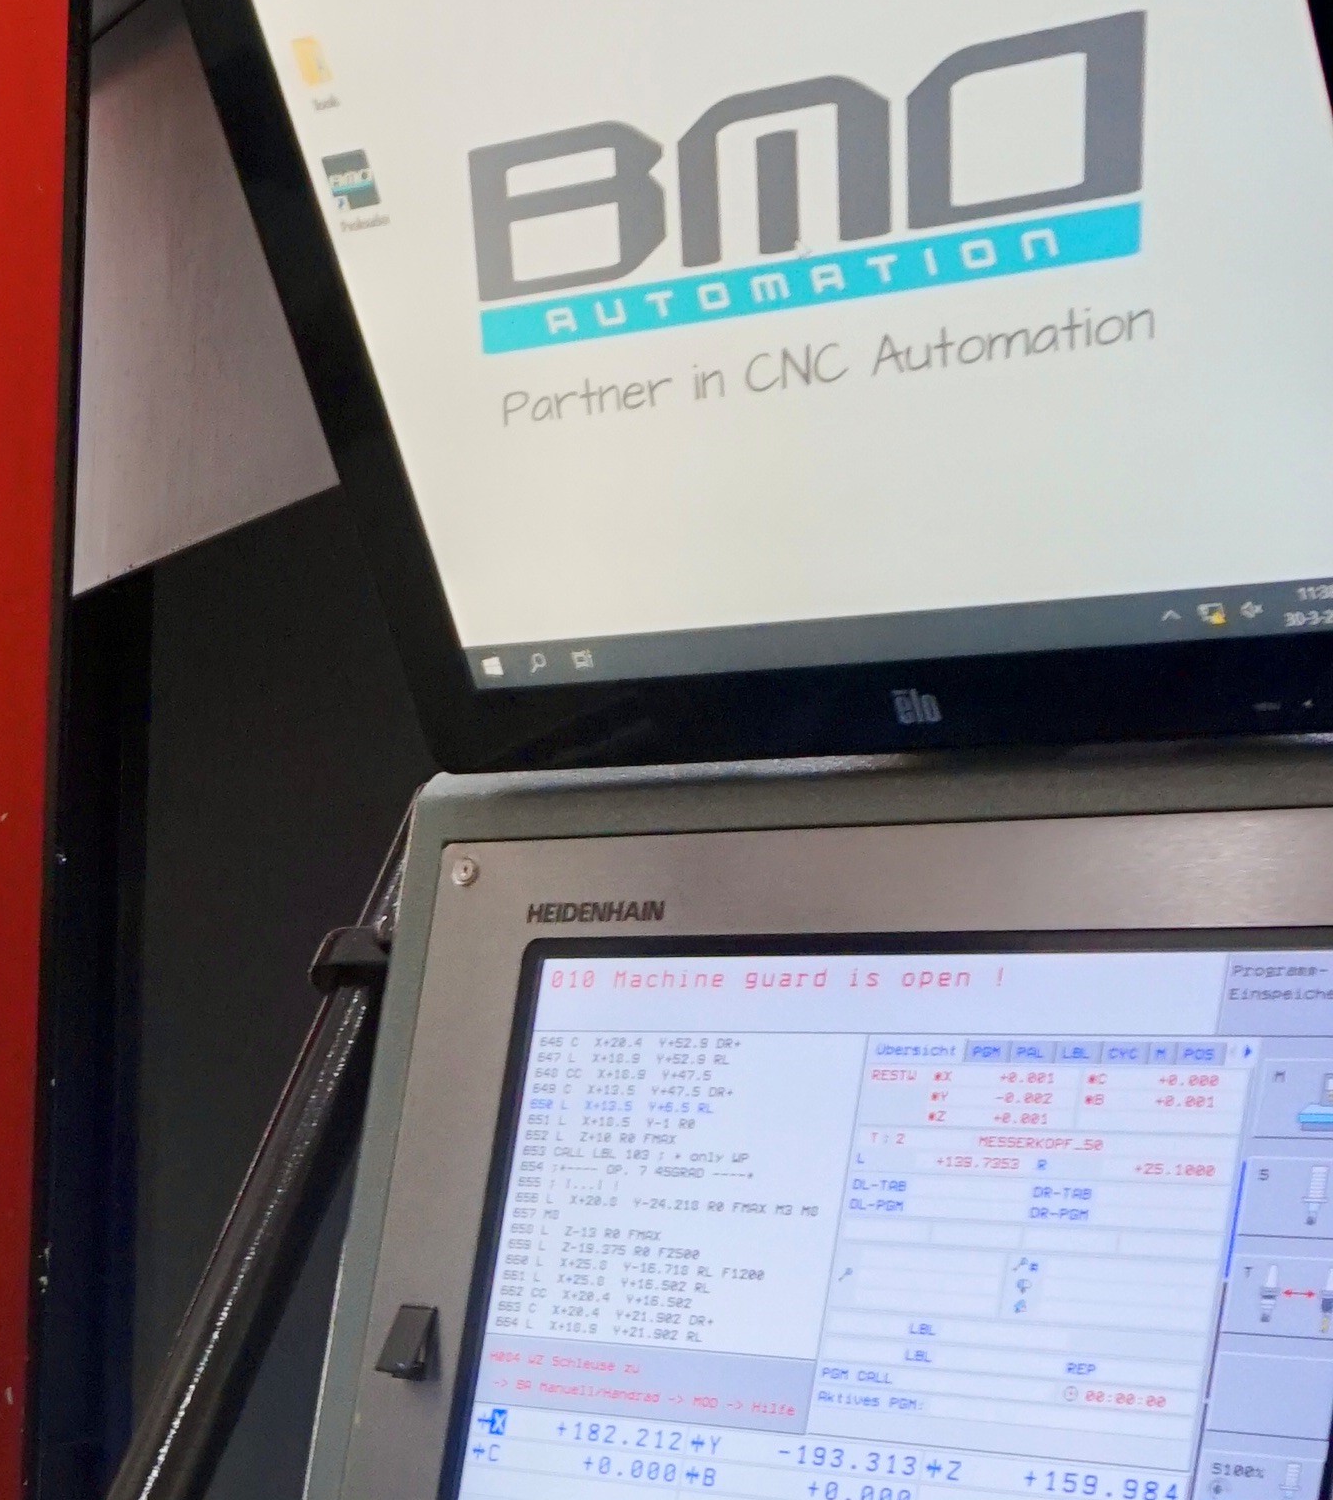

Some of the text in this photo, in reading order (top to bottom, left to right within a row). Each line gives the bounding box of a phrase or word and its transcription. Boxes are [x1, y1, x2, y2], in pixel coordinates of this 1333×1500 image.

[469, 10, 1147, 302] BMO
[546, 228, 1059, 334] AUTOMATION
[503, 304, 1156, 425] Partner in CNC Automation
[527, 901, 665, 924] HEIDENHAIN
[551, 968, 1005, 990] 010 Machine guard is open !
[999, 1071, 1054, 1084] +0.001
[1159, 1074, 1219, 1087] +0.000
[1155, 1095, 1214, 1108] +0.001
[994, 1112, 1048, 1124] +0.001
[909, 1323, 936, 1336] LBL
[552, 1356, 615, 1372] Schleuse
[905, 1349, 932, 1363] LBL
[822, 1367, 892, 1385] PGM CALL
[1066, 1362, 1096, 1375] REP
[752, 1402, 796, 1417] Hilfe
[558, 1421, 682, 1450] +182.212
[488, 1445, 500, 1461] C
[710, 1436, 721, 1454] Y
[584, 1457, 676, 1481] +0.000
[778, 1446, 918, 1475] -193.313
[702, 1468, 716, 1486] B
[947, 1461, 963, 1480] Z
